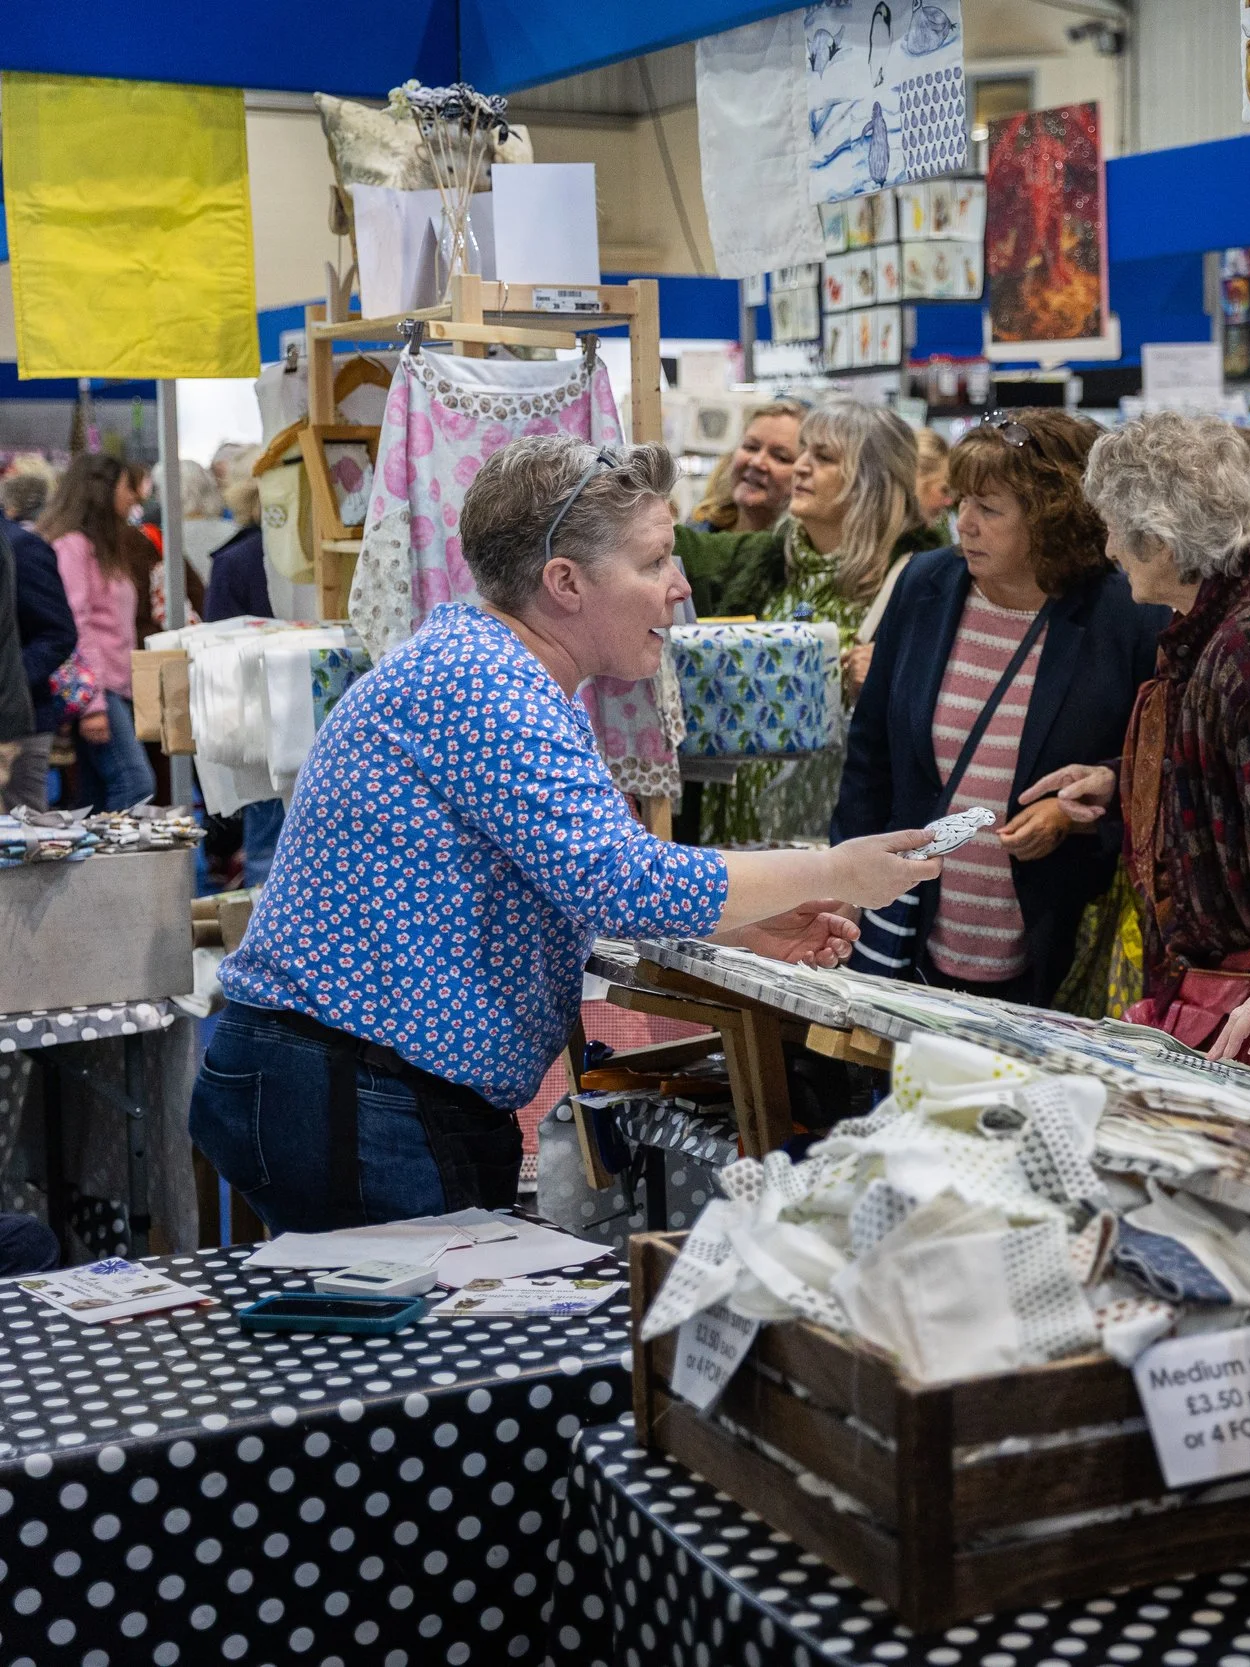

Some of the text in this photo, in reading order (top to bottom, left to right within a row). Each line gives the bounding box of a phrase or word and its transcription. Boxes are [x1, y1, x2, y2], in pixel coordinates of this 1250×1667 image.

[1149, 1359, 1245, 1389] Medium
[1186, 1388, 1243, 1416] £3.50
[1184, 1432, 1205, 1449] or
[1211, 1424, 1225, 1443] 4
